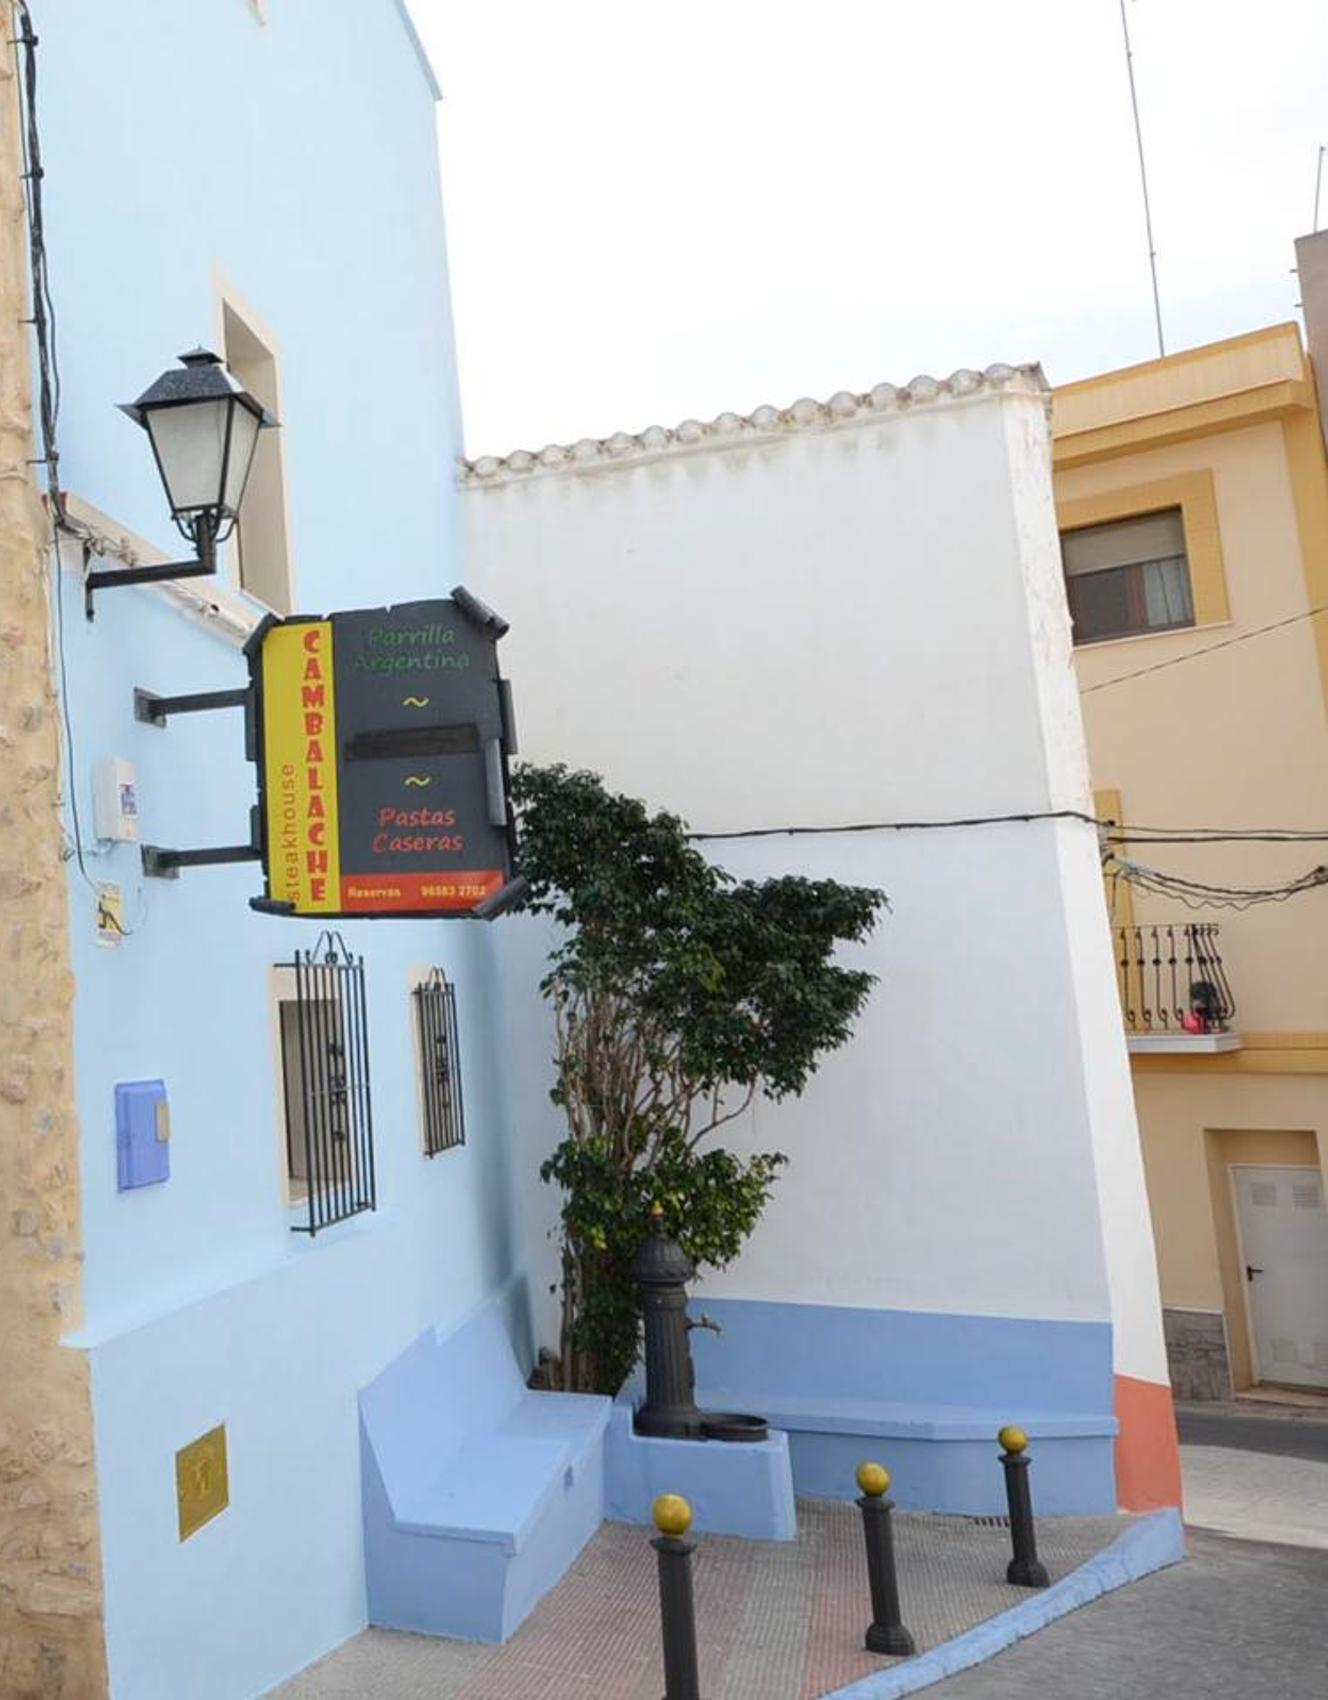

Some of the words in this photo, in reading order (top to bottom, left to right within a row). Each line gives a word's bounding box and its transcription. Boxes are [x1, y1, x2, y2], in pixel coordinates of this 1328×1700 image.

[370, 624, 455, 648] Parrilla
[353, 651, 470, 674] Argentina
[301, 630, 328, 901] CAMBALACHE
[379, 806, 456, 830] Pastas
[281, 763, 301, 901] steakhouse
[372, 833, 464, 853] Caseras
